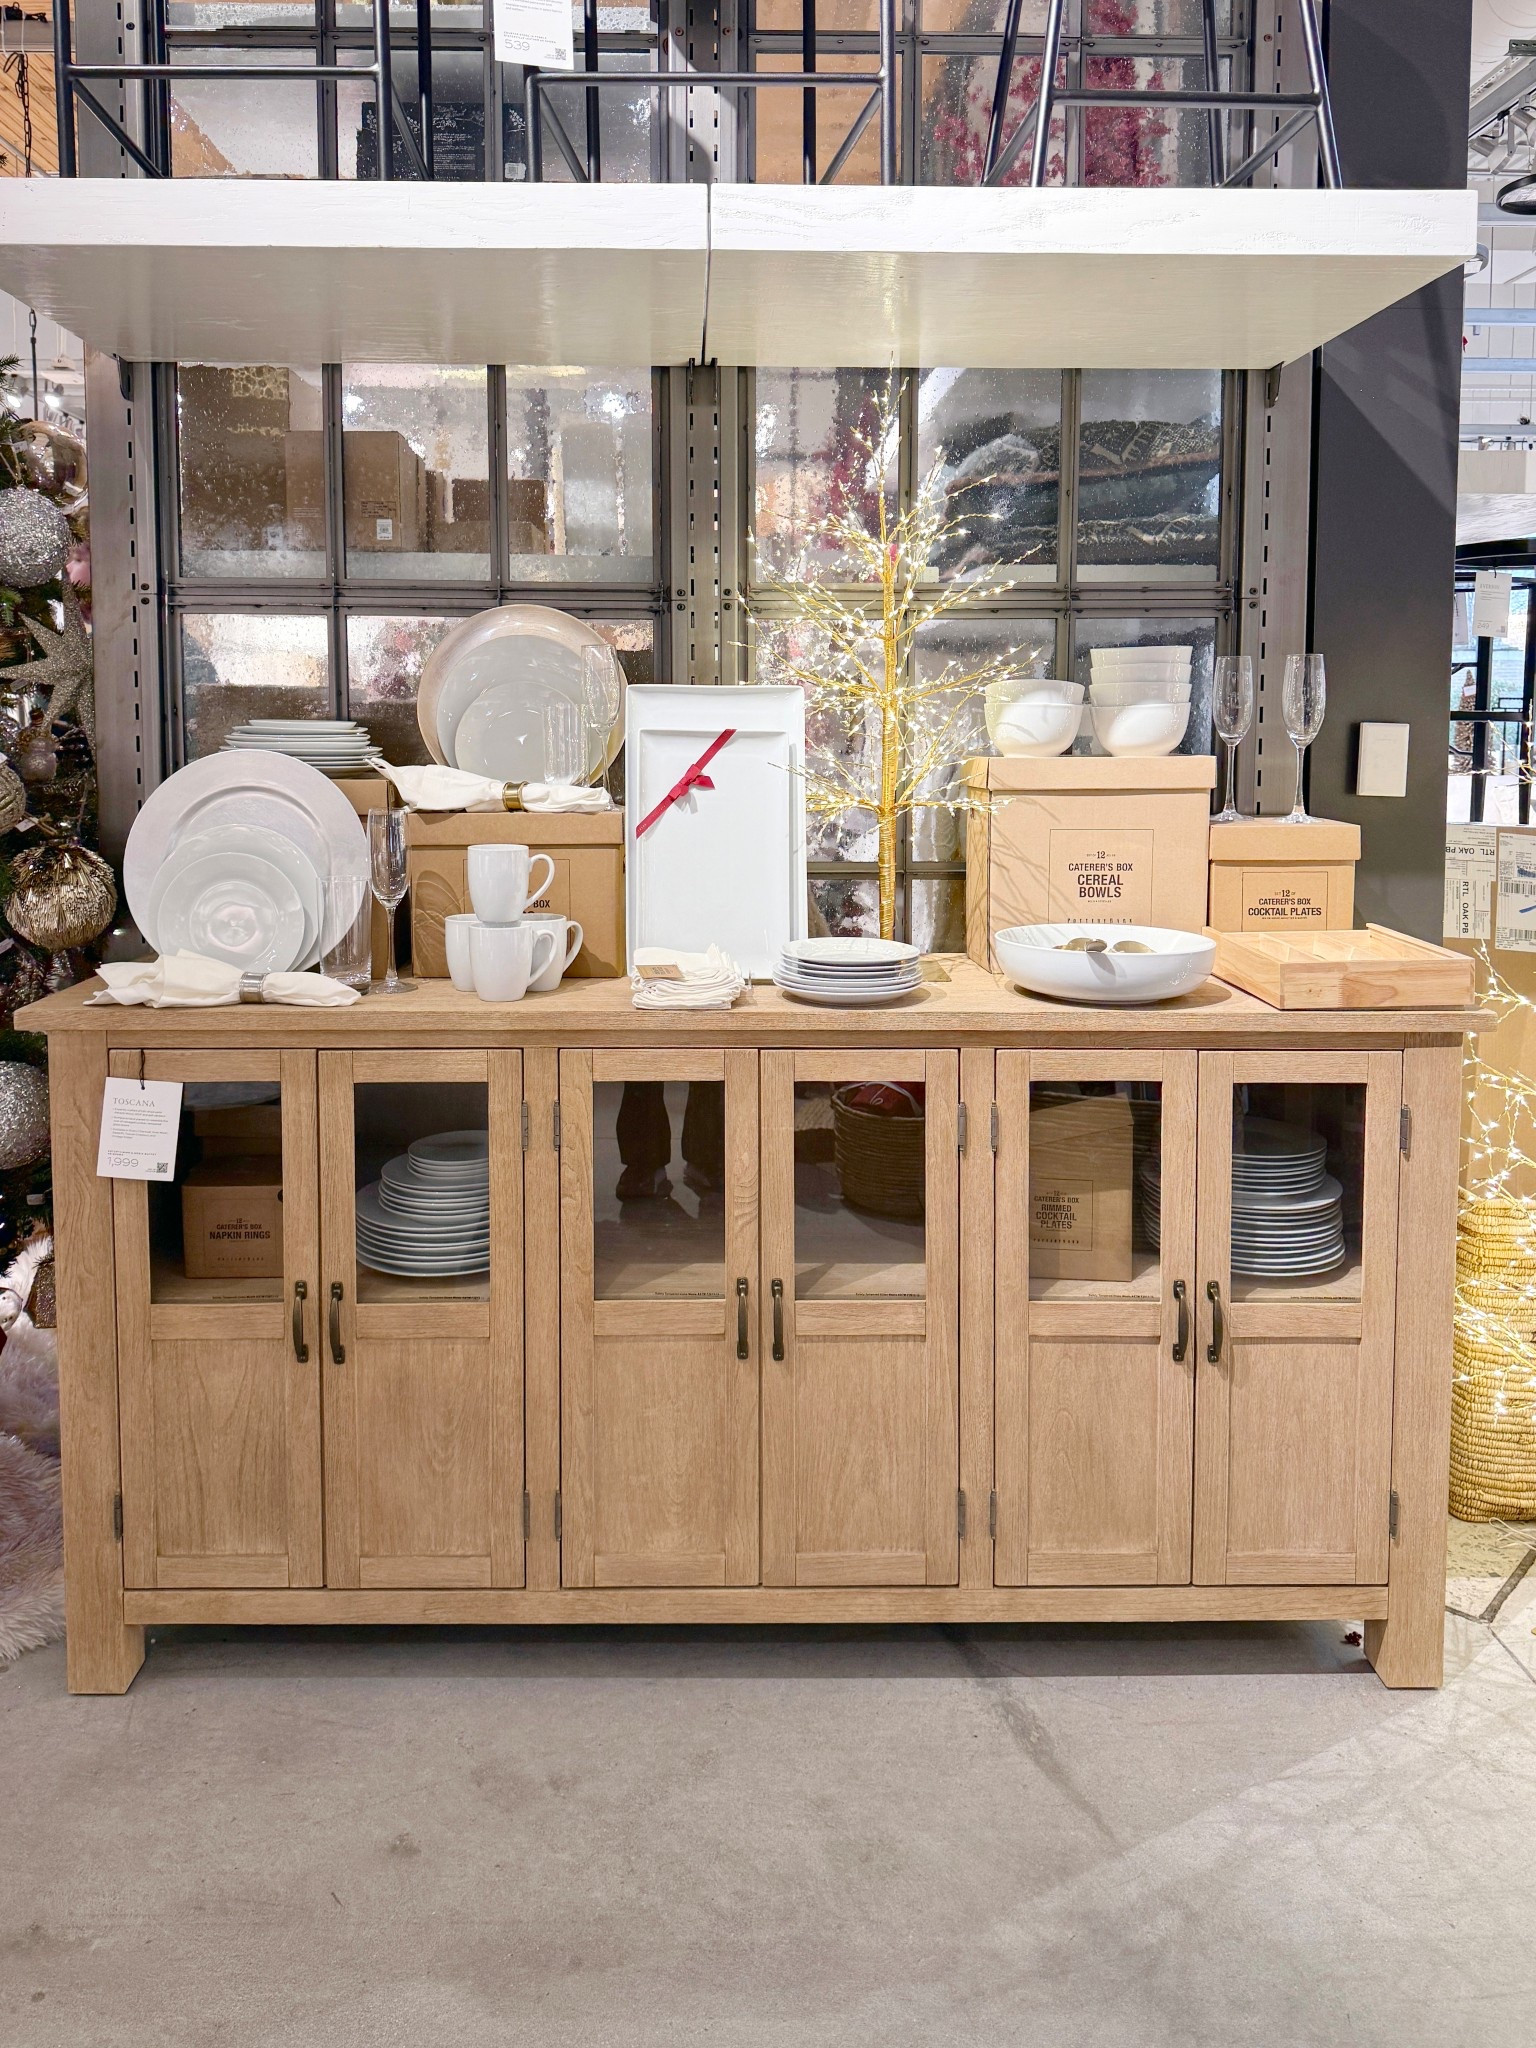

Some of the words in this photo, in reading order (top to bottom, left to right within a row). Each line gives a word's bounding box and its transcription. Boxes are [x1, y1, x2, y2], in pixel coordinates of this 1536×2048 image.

[505, 39, 530, 51] 539
[1097, 850, 1106, 859] 12
[1458, 847, 1475, 855] OAK
[1480, 848, 1495, 856] RTL
[1068, 863, 1113, 872] CATERER'S
[1116, 863, 1133, 871] BOX
[1077, 874, 1124, 885] CEREAL
[1078, 886, 1121, 898] BOWLS
[1282, 889, 1291, 897] 12
[533, 899, 550, 908] BOX
[1248, 907, 1288, 916] COCKTAIL
[1290, 907, 1322, 916] PLATES
[1462, 922, 1469, 934] PB
[113, 1097, 155, 1107] TOSCANA
[107, 1156, 139, 1168] 1,999
[1041, 1203, 1072, 1212] RIMMED
[1035, 1211, 1077, 1221] COCKTAIL
[1040, 1220, 1073, 1229] PLATES
[209, 1231, 242, 1239] NAPKIN
[244, 1231, 271, 1239] RINGS
